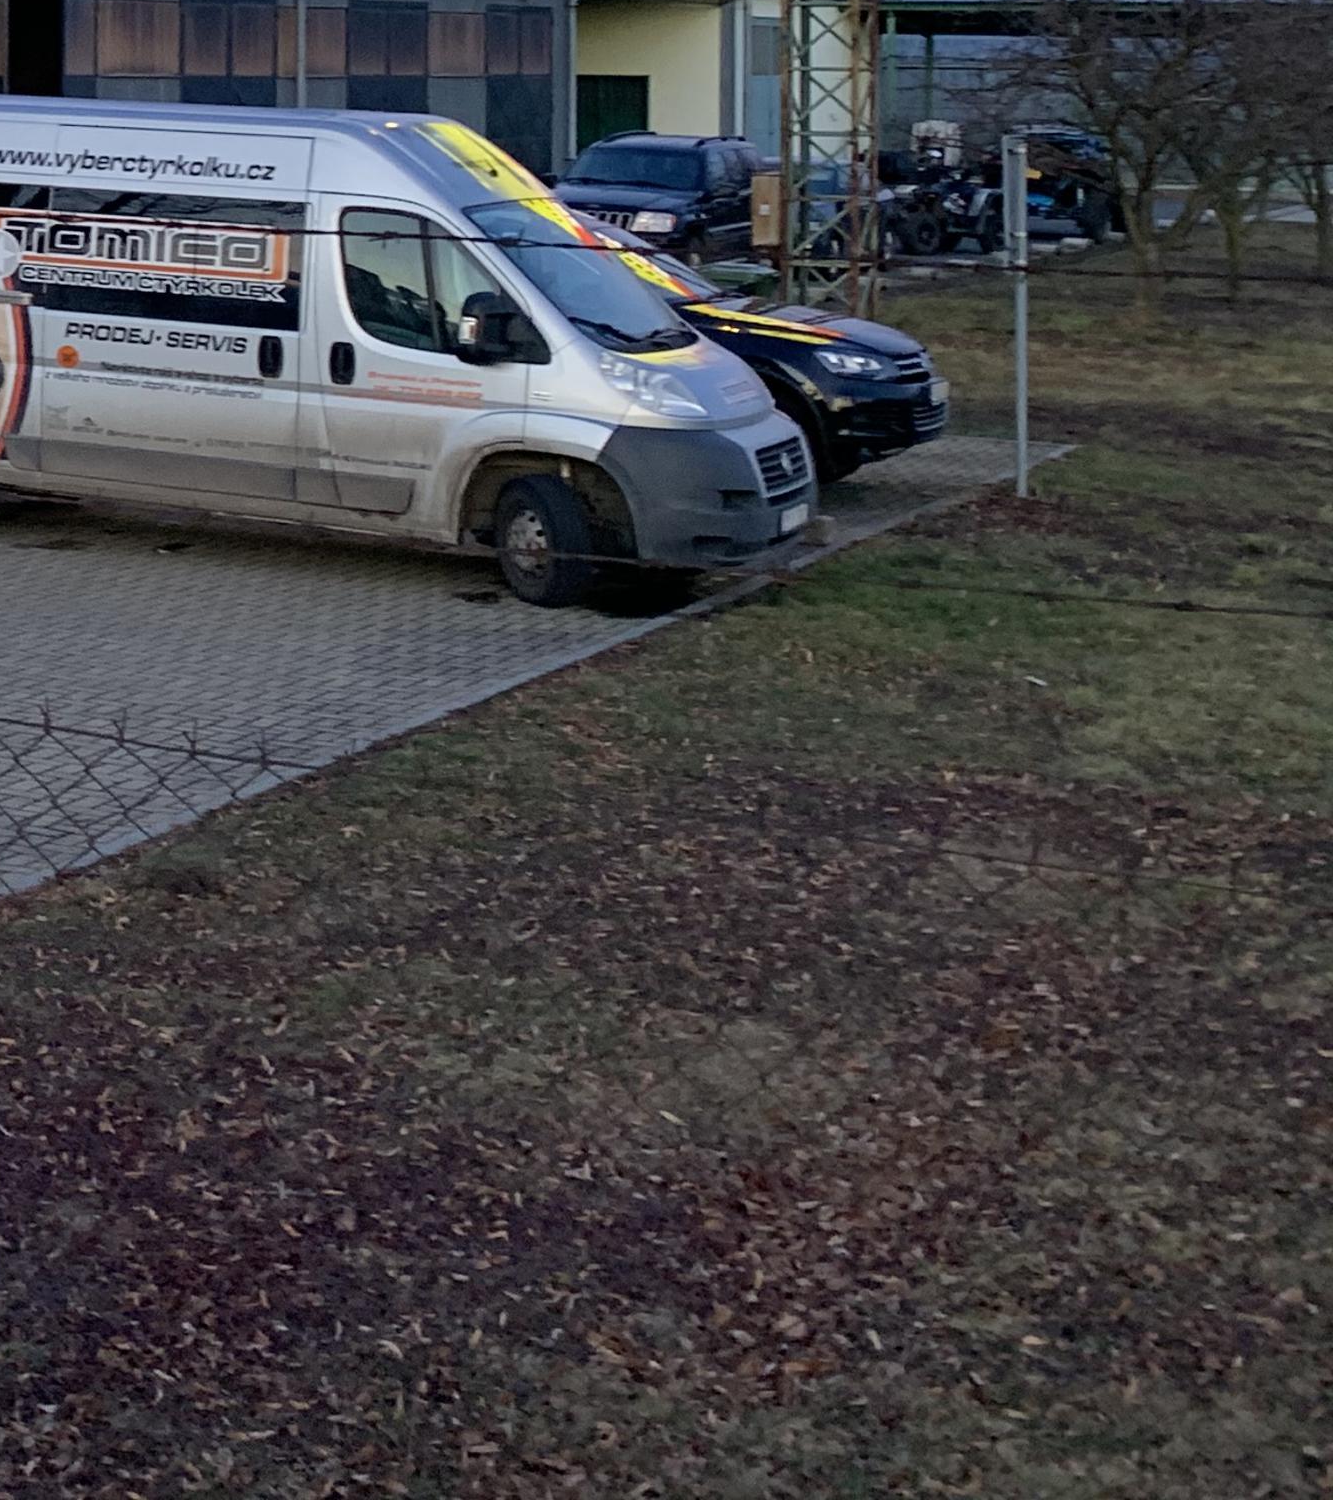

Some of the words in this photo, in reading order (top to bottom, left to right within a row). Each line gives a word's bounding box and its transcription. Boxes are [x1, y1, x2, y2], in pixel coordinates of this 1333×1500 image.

[19, 264, 137, 291] CENTRUM
[64, 321, 155, 346] PRODEJ
[165, 332, 248, 354] SERVIS
